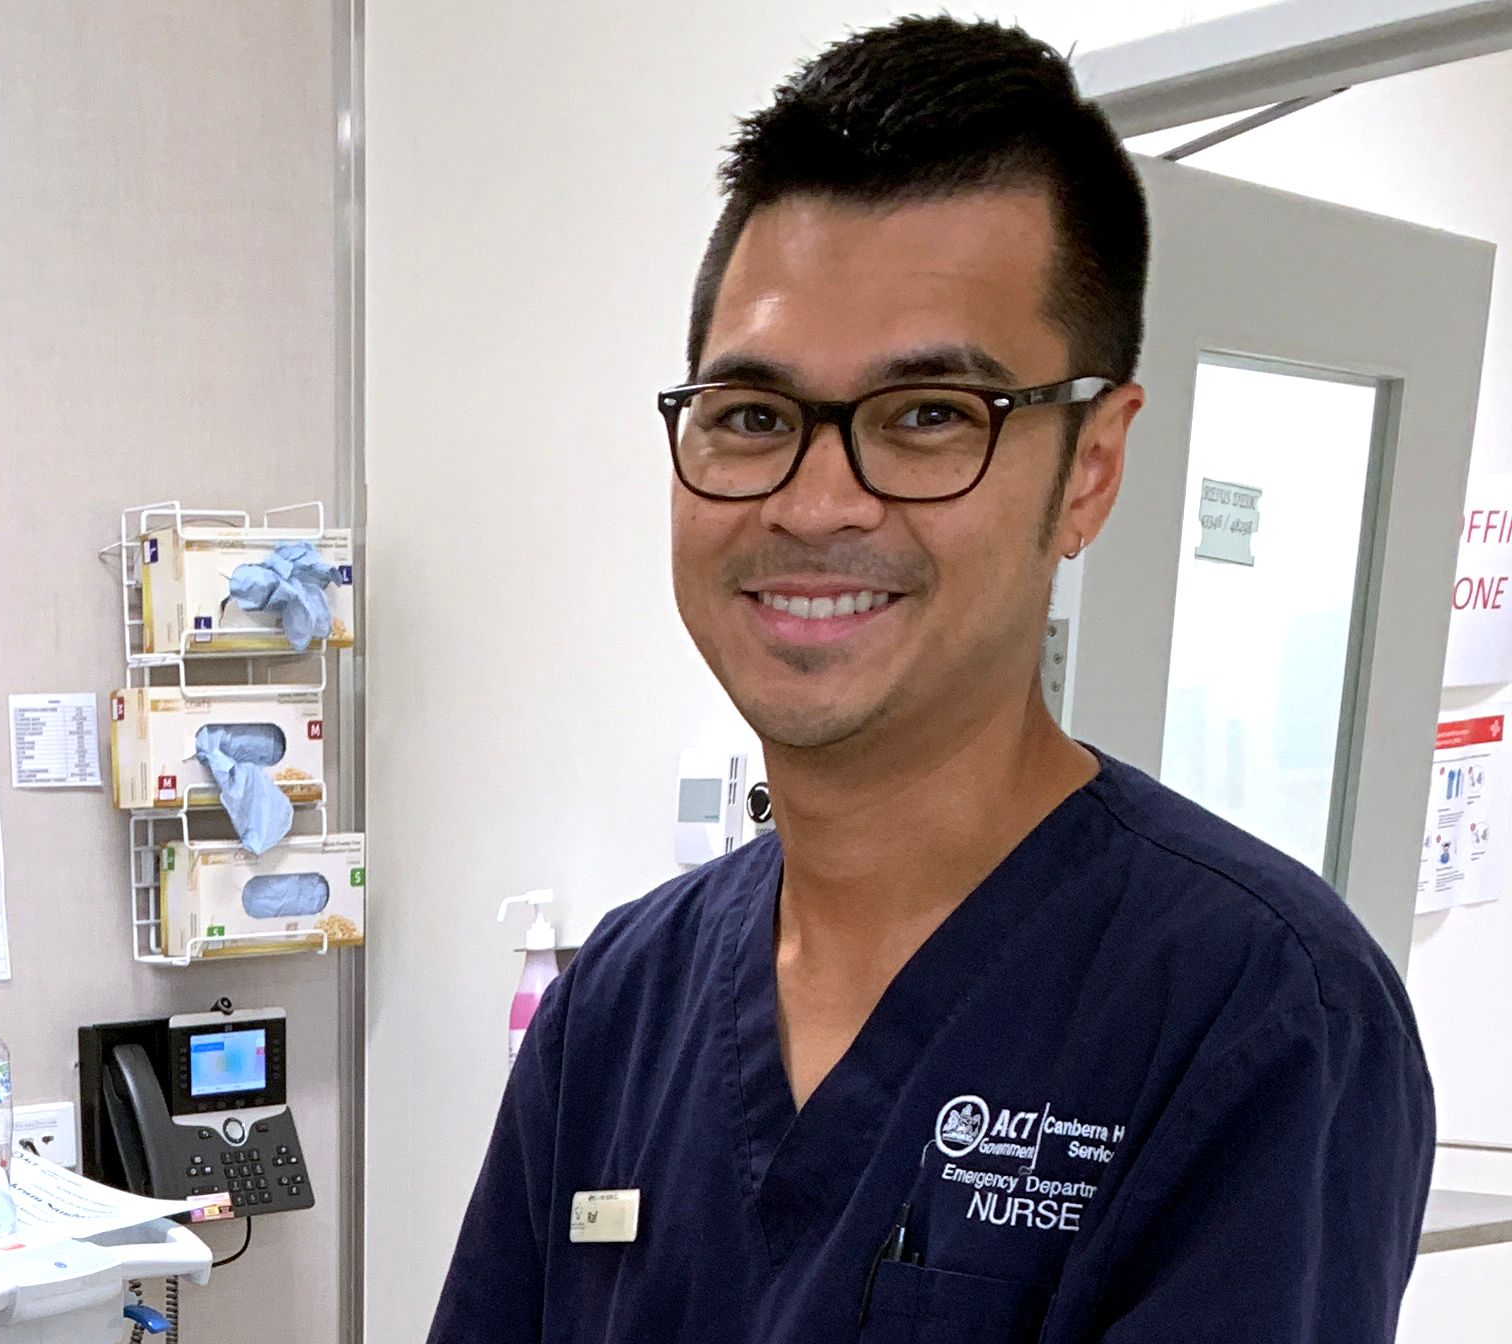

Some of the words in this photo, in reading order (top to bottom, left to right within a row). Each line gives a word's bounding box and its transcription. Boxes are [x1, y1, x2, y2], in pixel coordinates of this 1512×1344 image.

[1461, 510, 1512, 543] FFI
[1452, 576, 1509, 610] ONE
[310, 724, 321, 737] M
[162, 778, 172, 788] M
[991, 1109, 1038, 1140] ACT
[1043, 1116, 1108, 1141] Canberra
[1112, 1125, 1126, 1143] H
[1068, 1140, 1116, 1163] Servic
[941, 1163, 1019, 1192] Emergency
[1025, 1176, 1098, 1199] Departm
[966, 1191, 1084, 1231] NURSE
